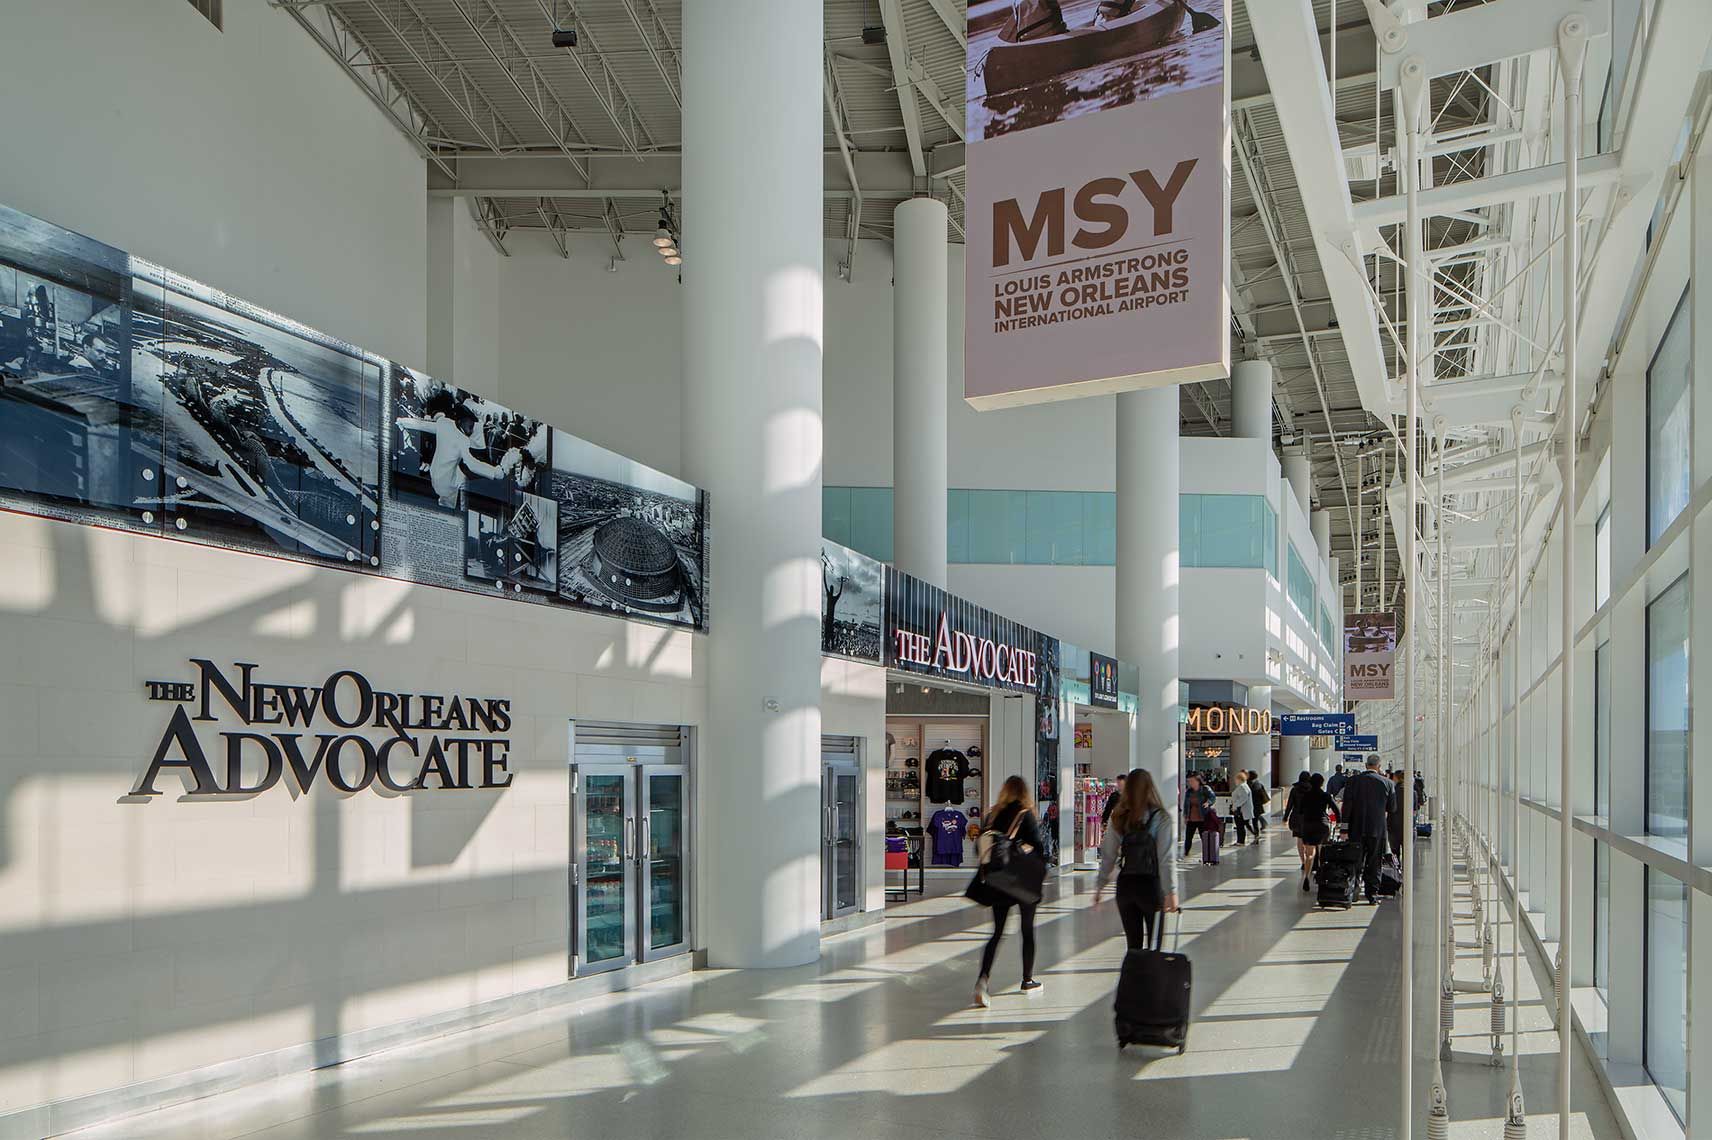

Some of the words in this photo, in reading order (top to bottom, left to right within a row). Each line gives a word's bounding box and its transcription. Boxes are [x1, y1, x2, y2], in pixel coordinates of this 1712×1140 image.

[992, 158, 1199, 268] MSY
[994, 274, 1051, 298] LOUIS
[1056, 249, 1189, 287] ARMSTRONG
[994, 291, 1054, 319] NEW
[1060, 267, 1189, 307] ORLEANS
[994, 303, 1114, 333] INTERNATIONAL
[1118, 289, 1189, 313] AIRPORT
[895, 629, 931, 665] THE
[932, 611, 1037, 688] ADVOCATE
[1350, 663, 1390, 677] MSY
[145, 680, 196, 702] THE
[1186, 706, 1272, 735] MONDO
[128, 704, 513, 796] ADVOCATE
